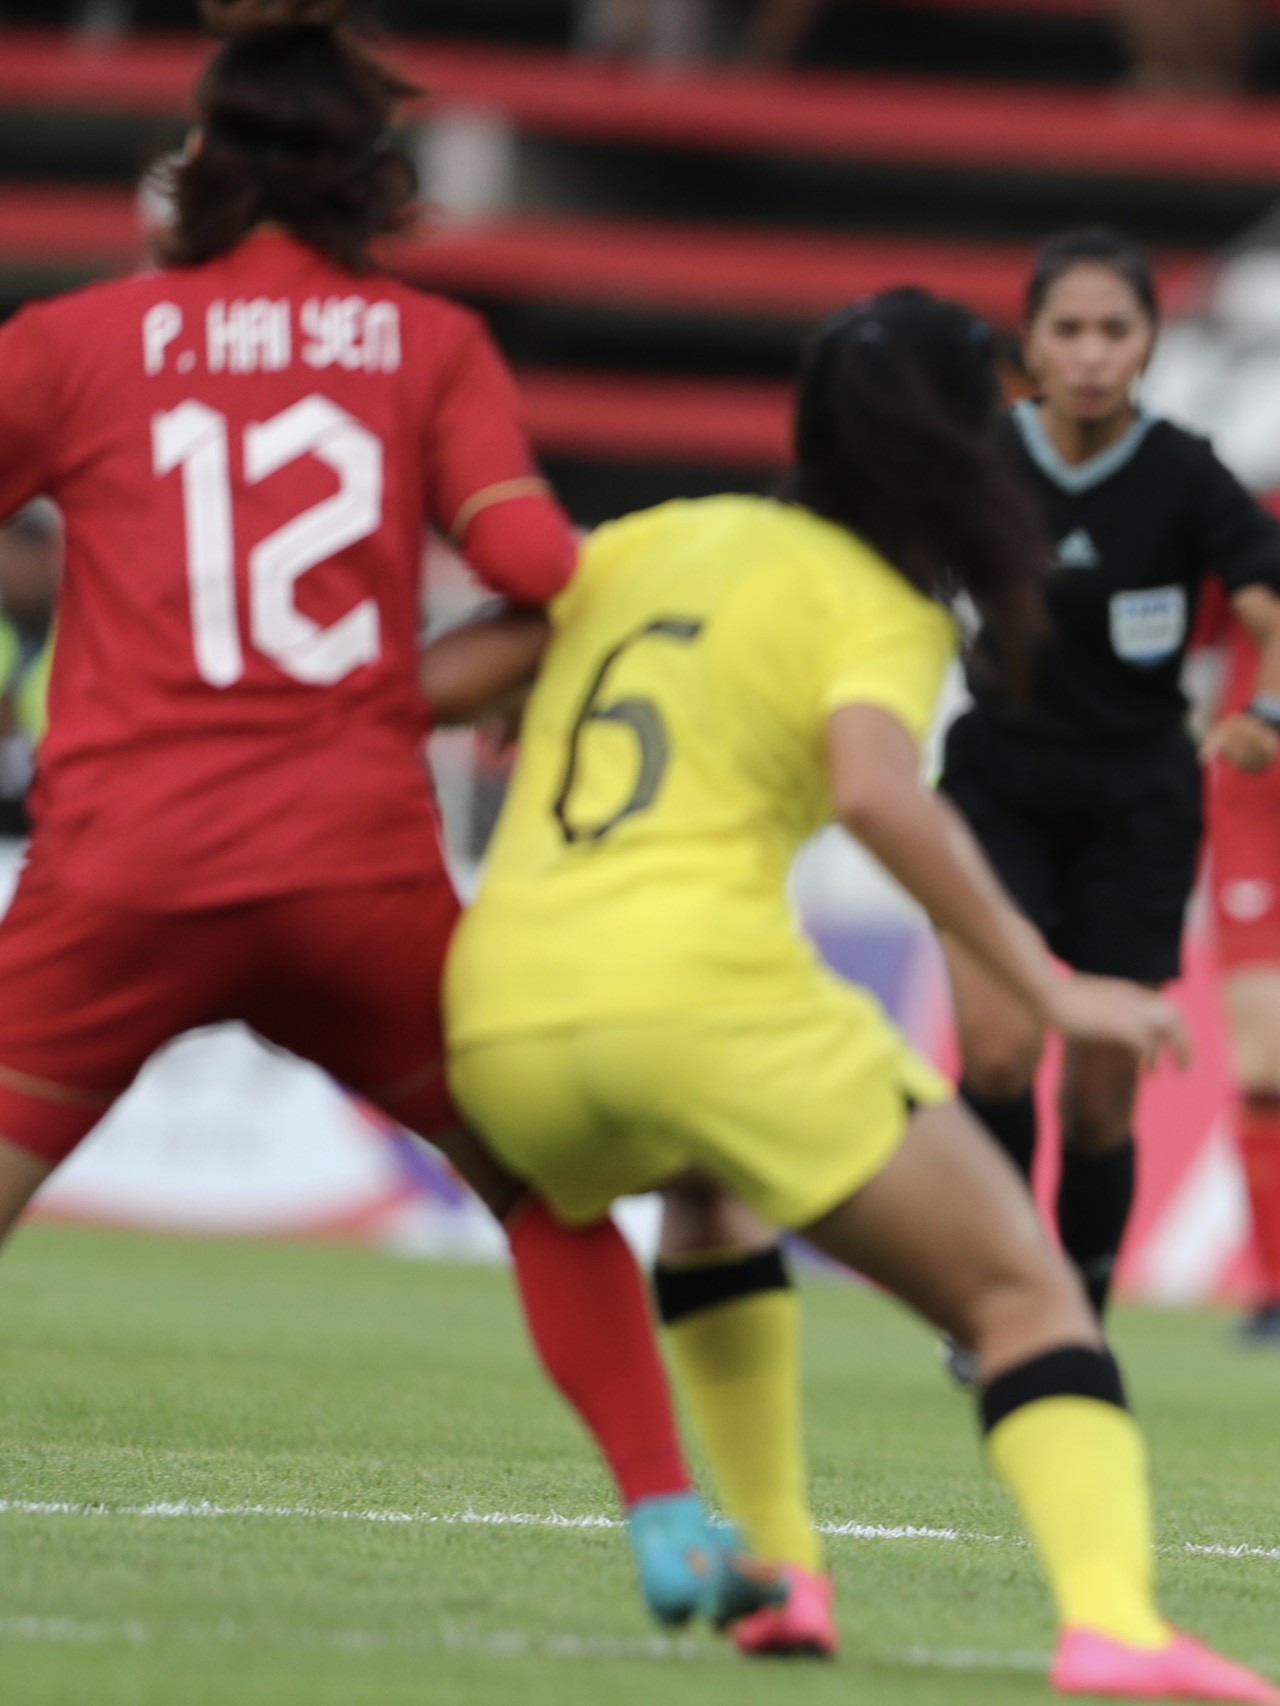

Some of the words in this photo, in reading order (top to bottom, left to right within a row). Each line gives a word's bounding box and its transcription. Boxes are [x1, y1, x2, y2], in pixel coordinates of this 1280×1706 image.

[142, 300, 197, 377] P.
[205, 296, 292, 376] HAI
[152, 394, 383, 687] 12
[555, 618, 700, 843] 6
